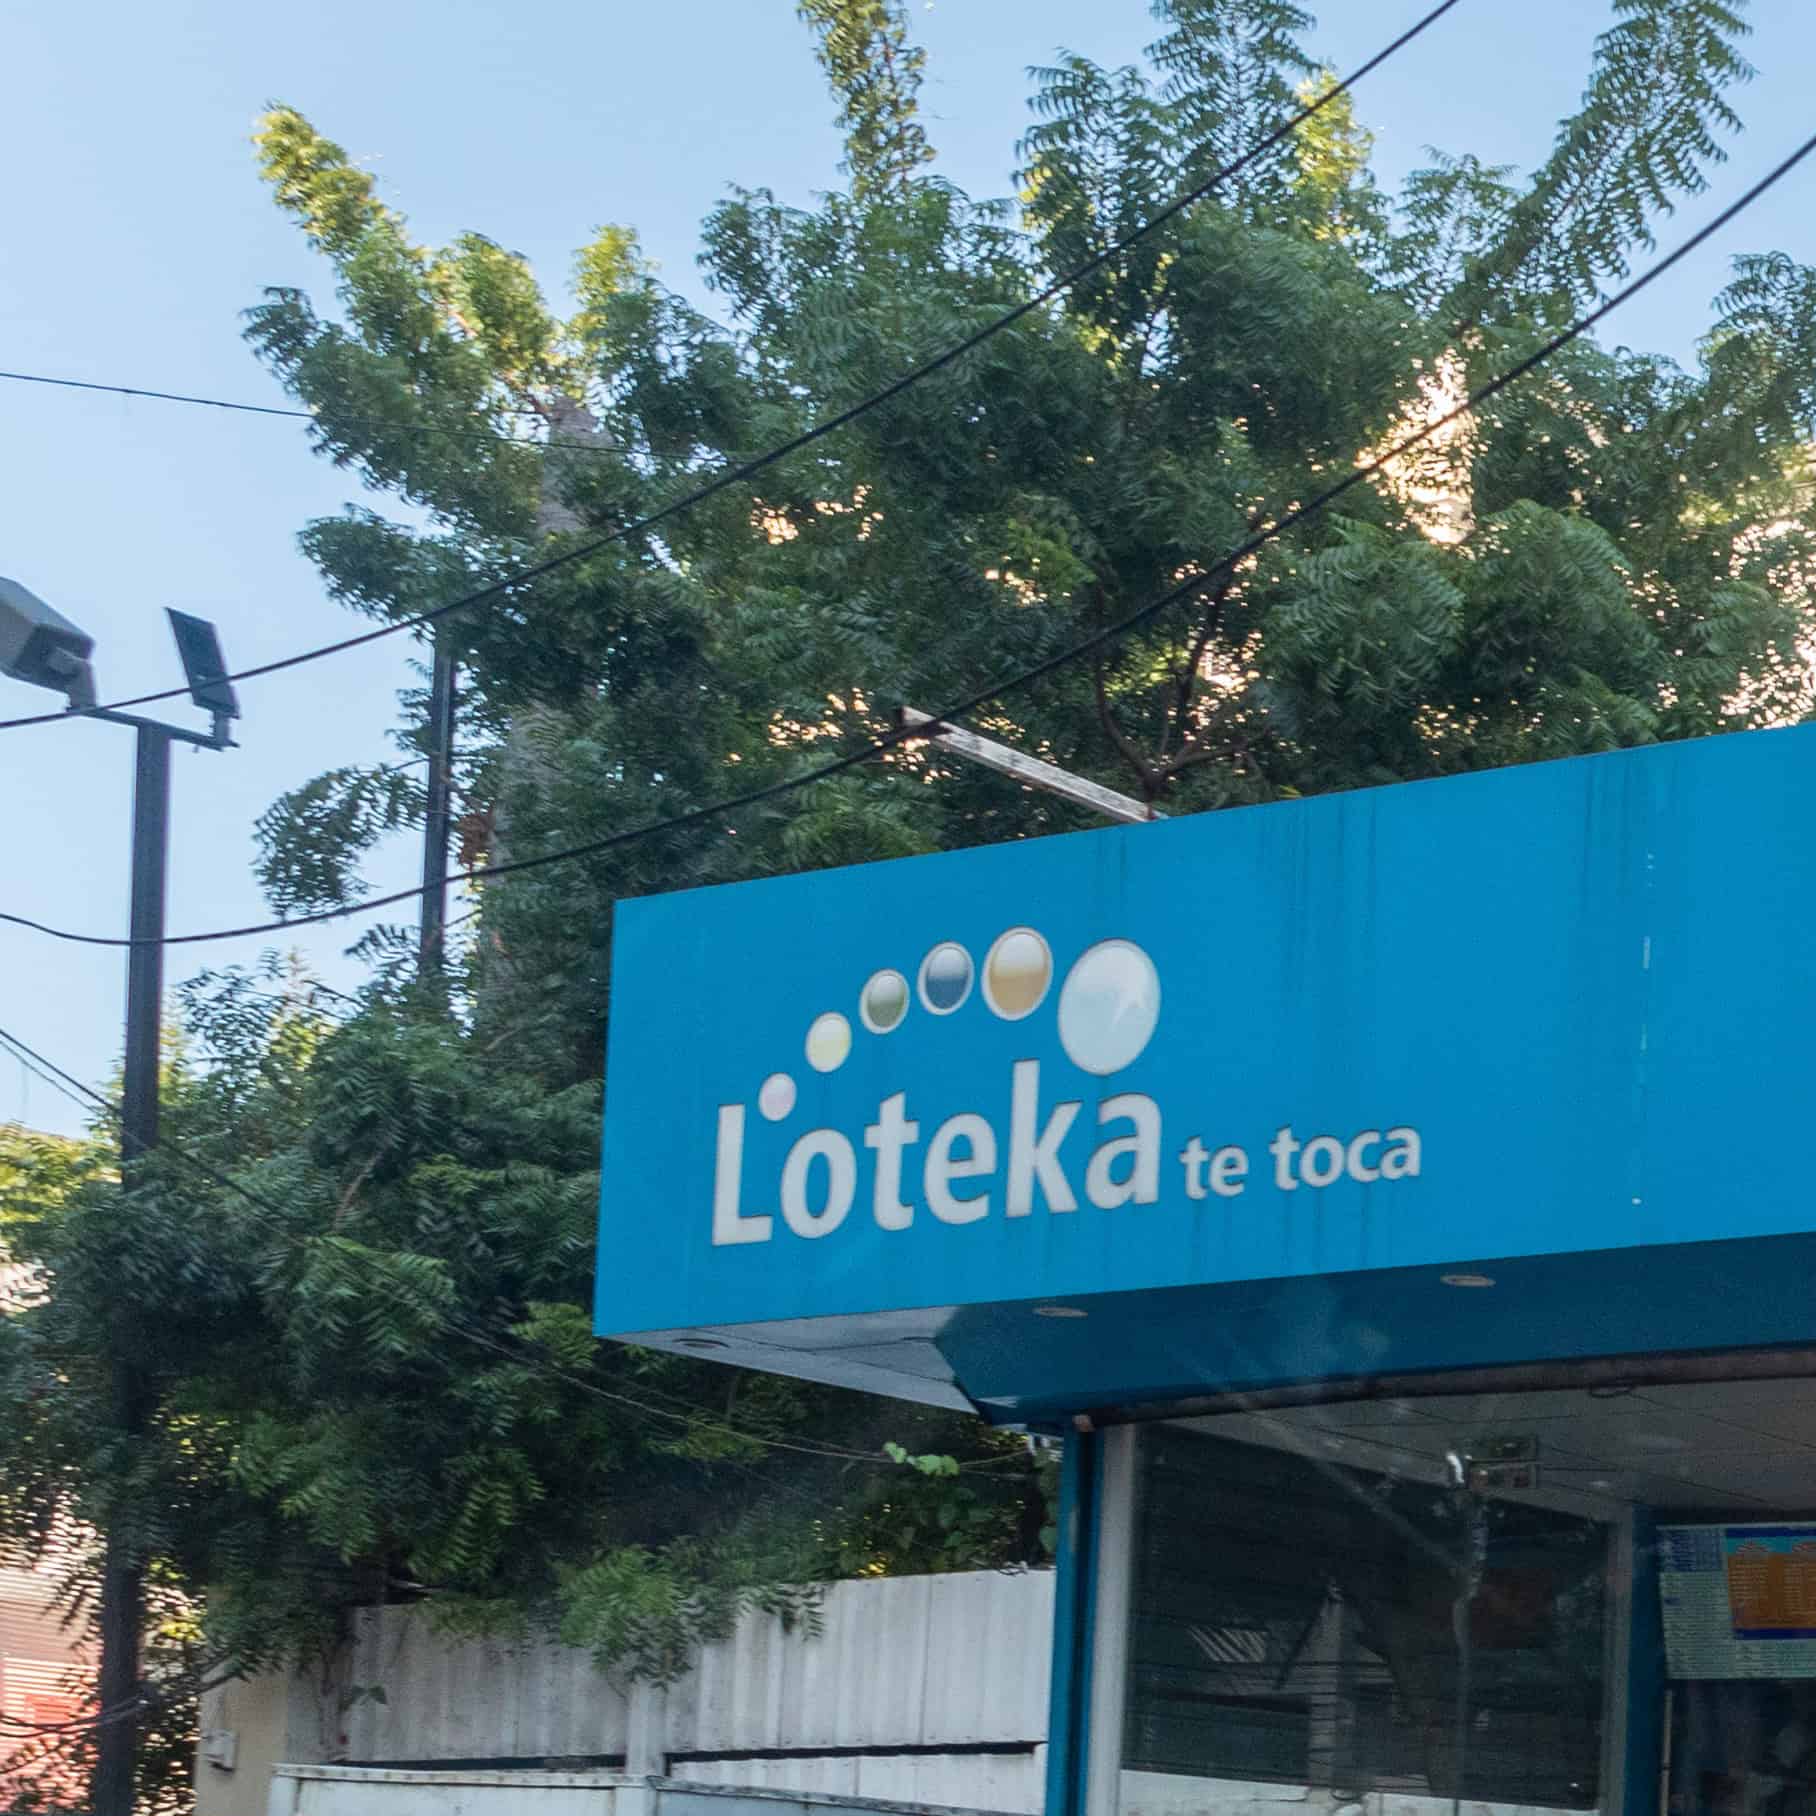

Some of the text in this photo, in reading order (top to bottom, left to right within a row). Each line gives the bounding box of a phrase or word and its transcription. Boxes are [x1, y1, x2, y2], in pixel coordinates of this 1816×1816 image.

[712, 1059, 1421, 1246] Loteka te toca
